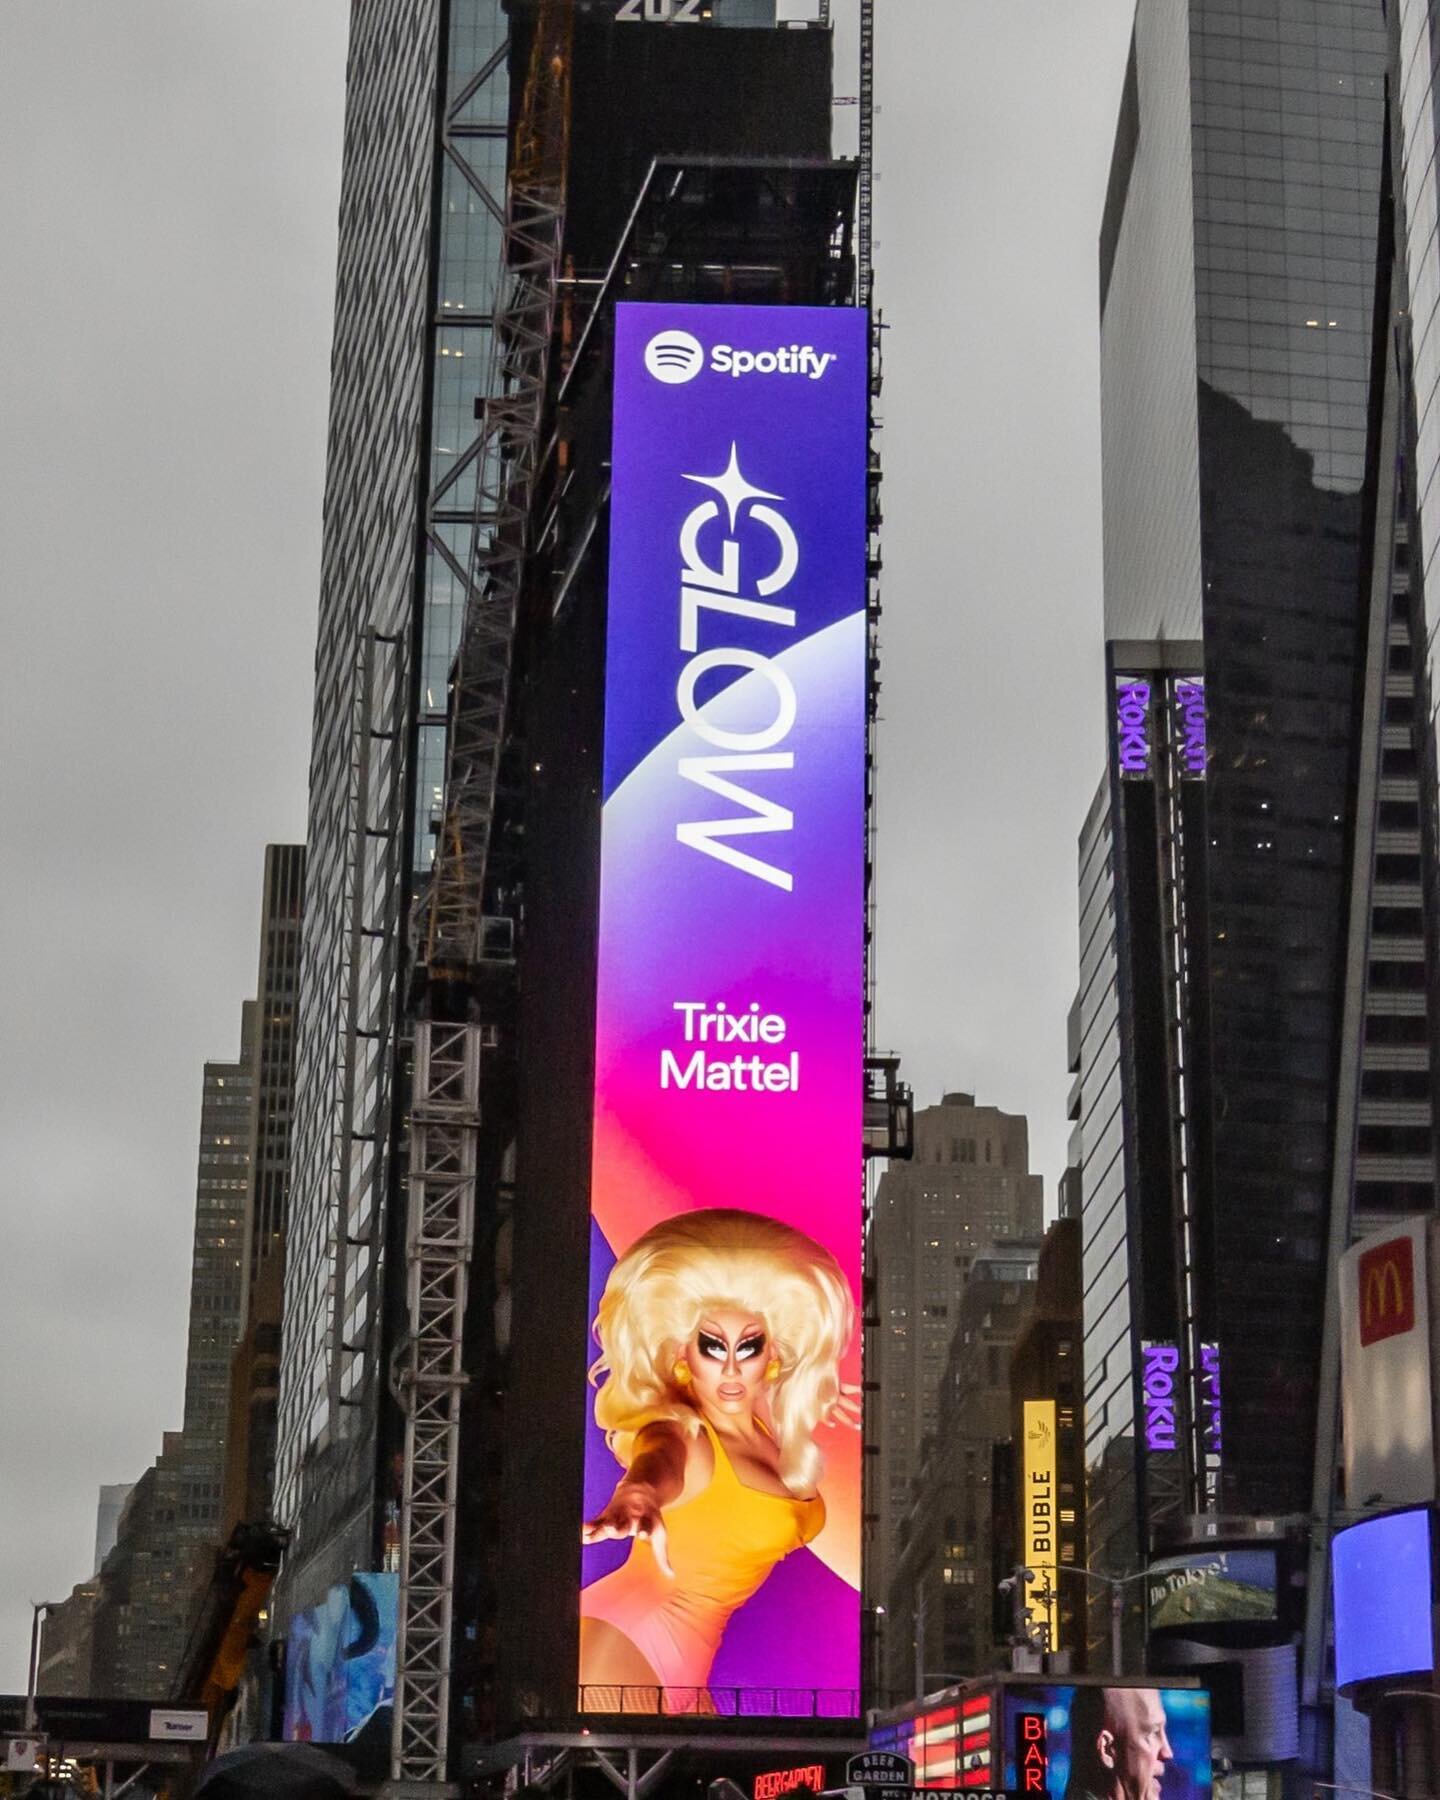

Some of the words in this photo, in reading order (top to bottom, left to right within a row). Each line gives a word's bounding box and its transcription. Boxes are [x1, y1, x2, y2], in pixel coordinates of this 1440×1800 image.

[710, 344, 831, 380] Spotify
[676, 500, 799, 893] GLOW
[672, 1002, 786, 1043] Trixie
[660, 1050, 799, 1092] Mattel
[863, 1754, 895, 1768] BEER
[1023, 1717, 1043, 1792] BAR
[853, 1770, 905, 1782] GARDEN
